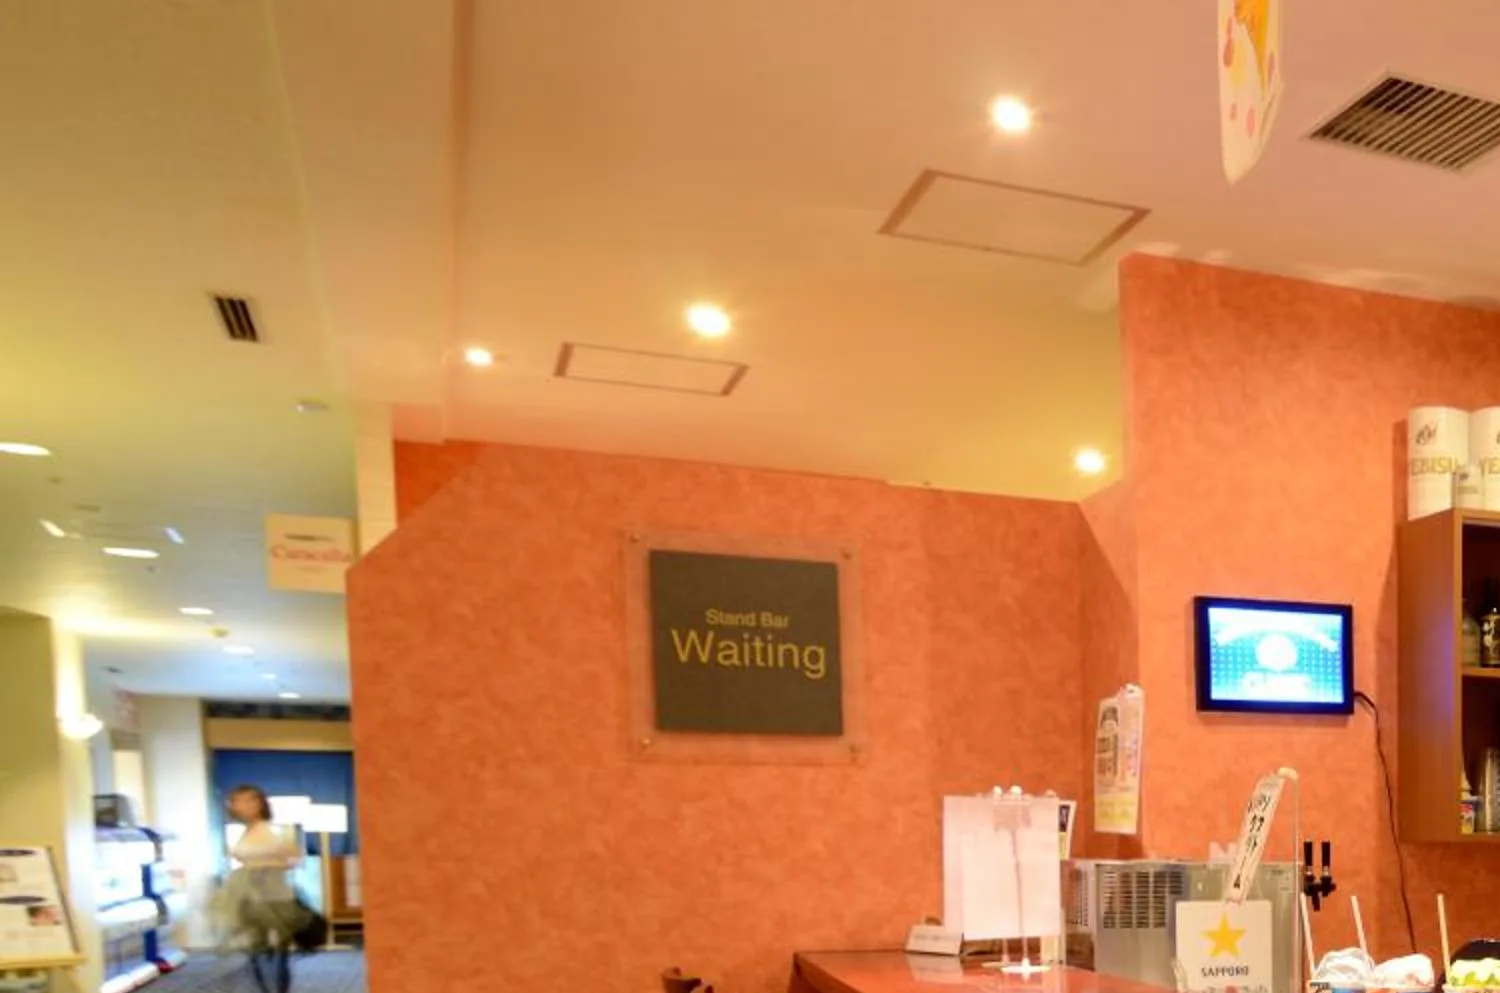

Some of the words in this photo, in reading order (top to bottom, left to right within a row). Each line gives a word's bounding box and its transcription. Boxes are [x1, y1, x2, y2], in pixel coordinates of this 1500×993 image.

[705, 608, 756, 626] Stand
[761, 612, 790, 628] Bar
[671, 628, 826, 679] Waiting
[1201, 966, 1249, 977] SAPPORO
